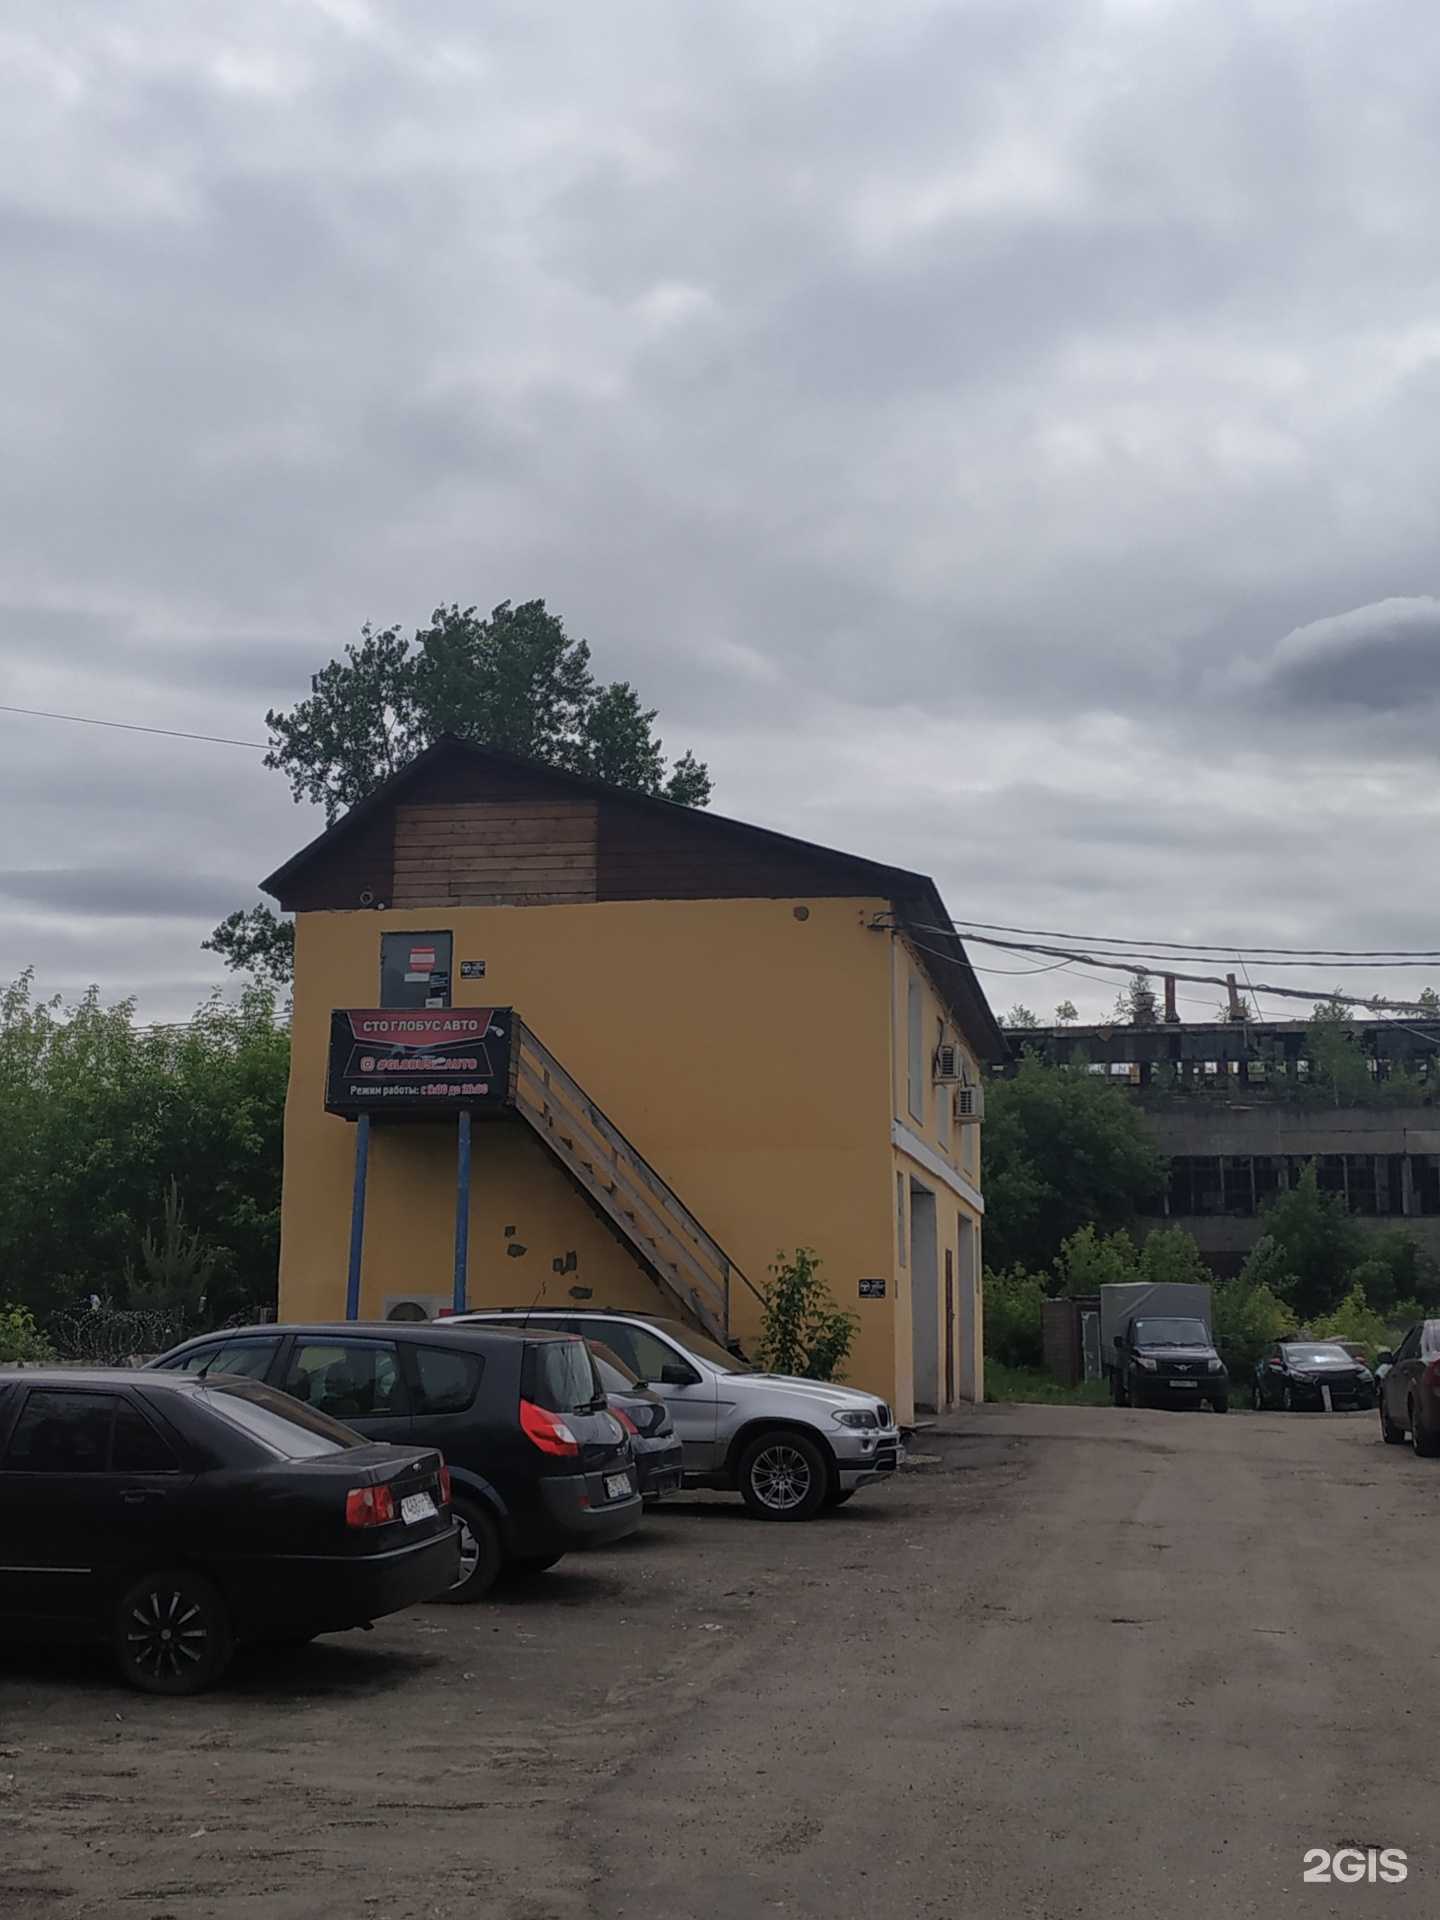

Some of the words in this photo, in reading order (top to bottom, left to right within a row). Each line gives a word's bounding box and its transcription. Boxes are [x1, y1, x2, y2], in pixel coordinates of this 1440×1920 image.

[363, 1020, 388, 1032] СТО
[390, 1020, 440, 1032] ГЛОБУС
[443, 1020, 478, 1031] АВТО
[350, 1085, 382, 1096] Режим
[382, 1085, 420, 1097] работы:
